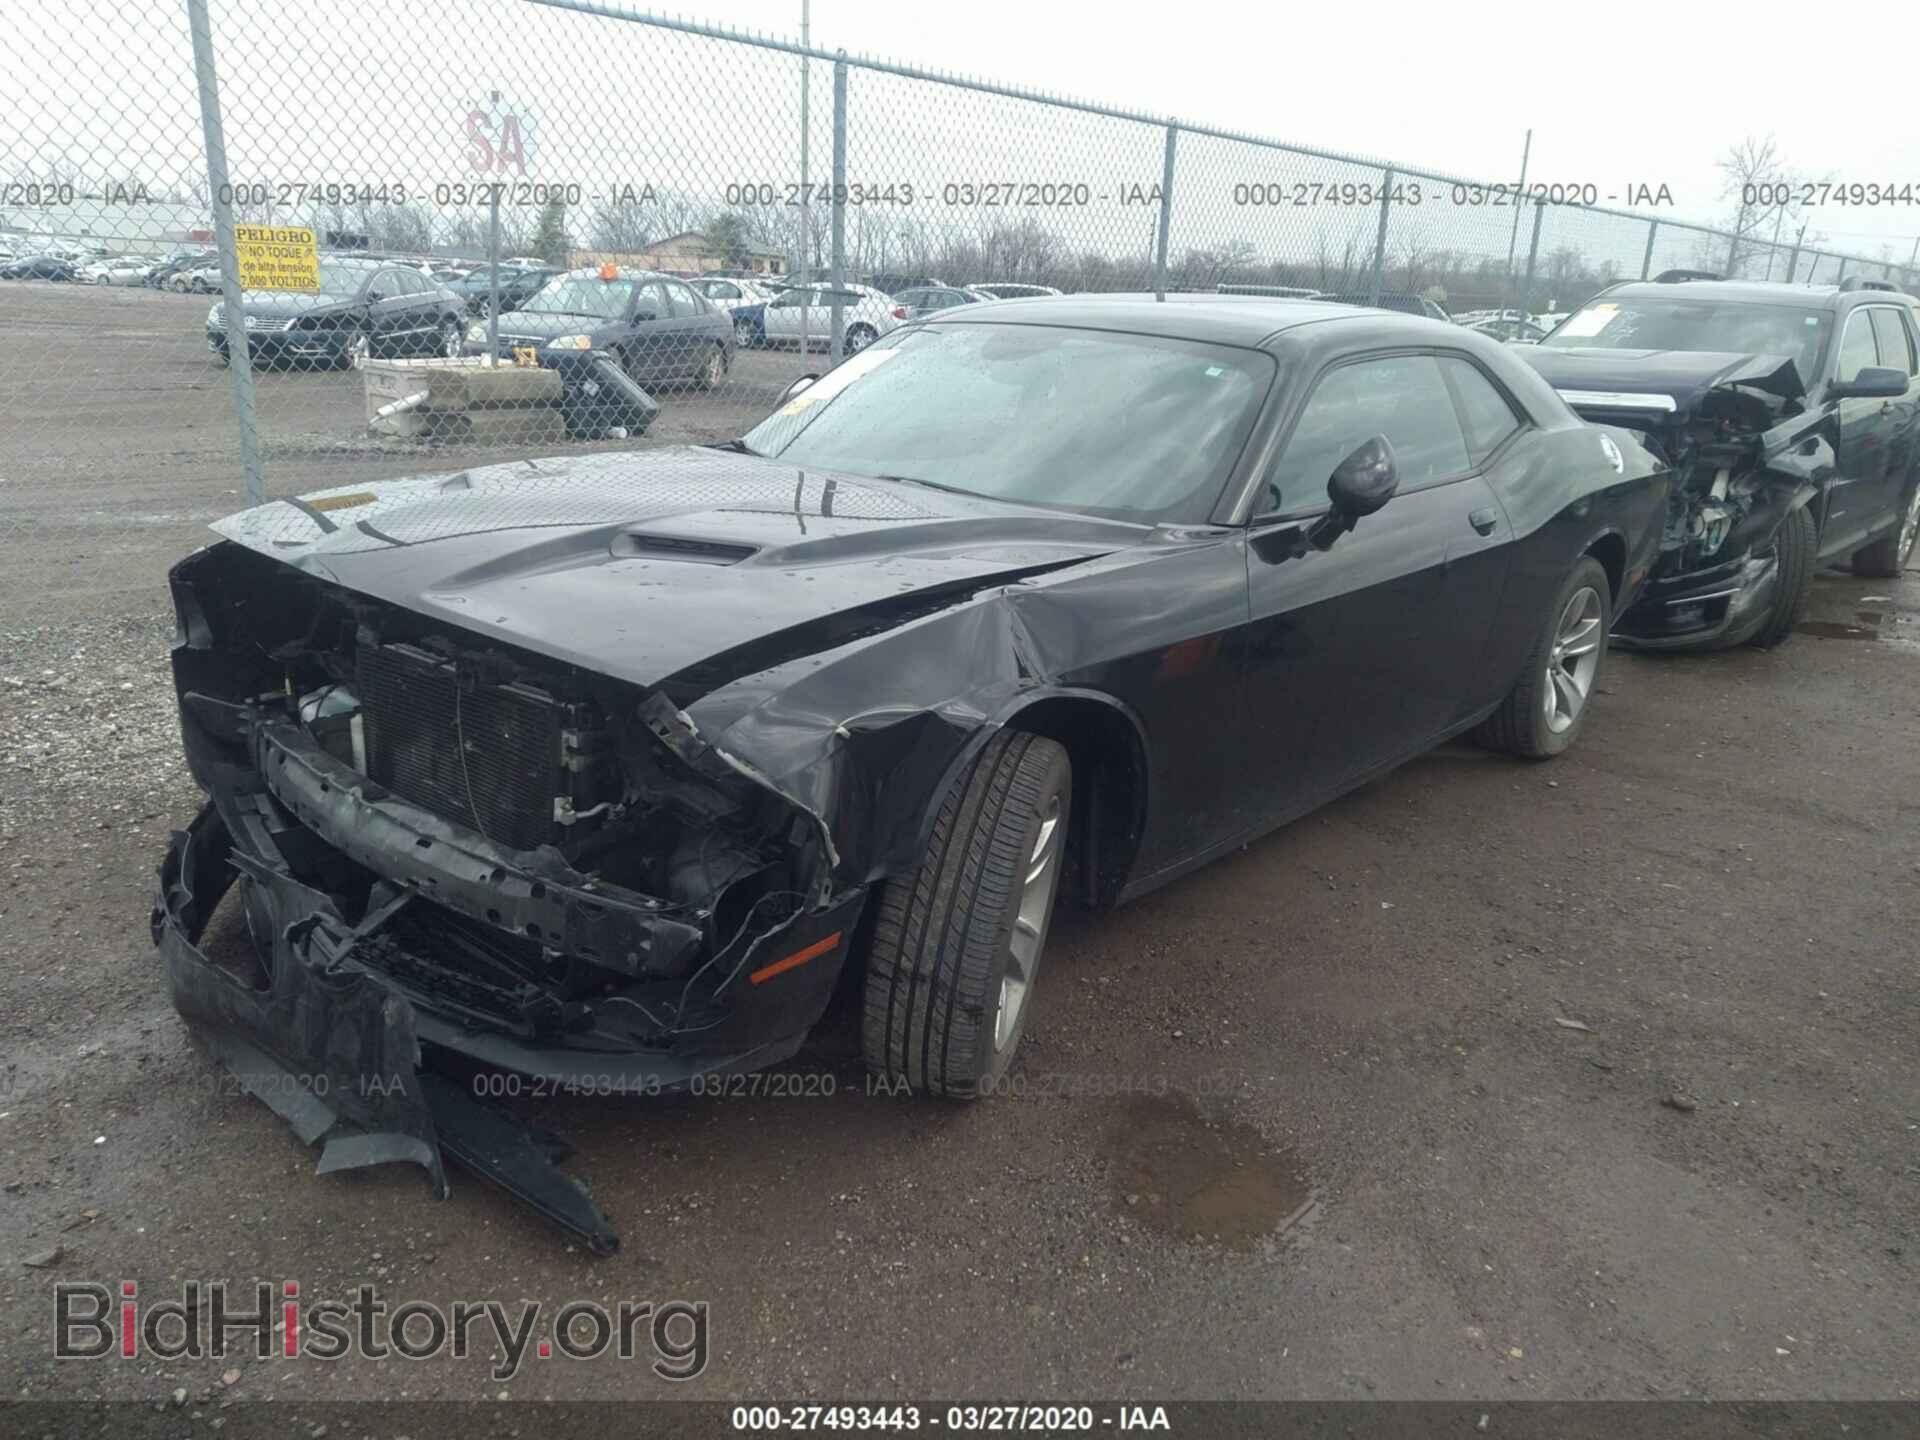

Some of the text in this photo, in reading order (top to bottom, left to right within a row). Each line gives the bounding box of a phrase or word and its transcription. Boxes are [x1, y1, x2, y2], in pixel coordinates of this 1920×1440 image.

[236, 228, 312, 243] PELIGRO
[249, 245, 302, 259] NO TOQUE
[269, 275, 317, 288] VOLTIOS
